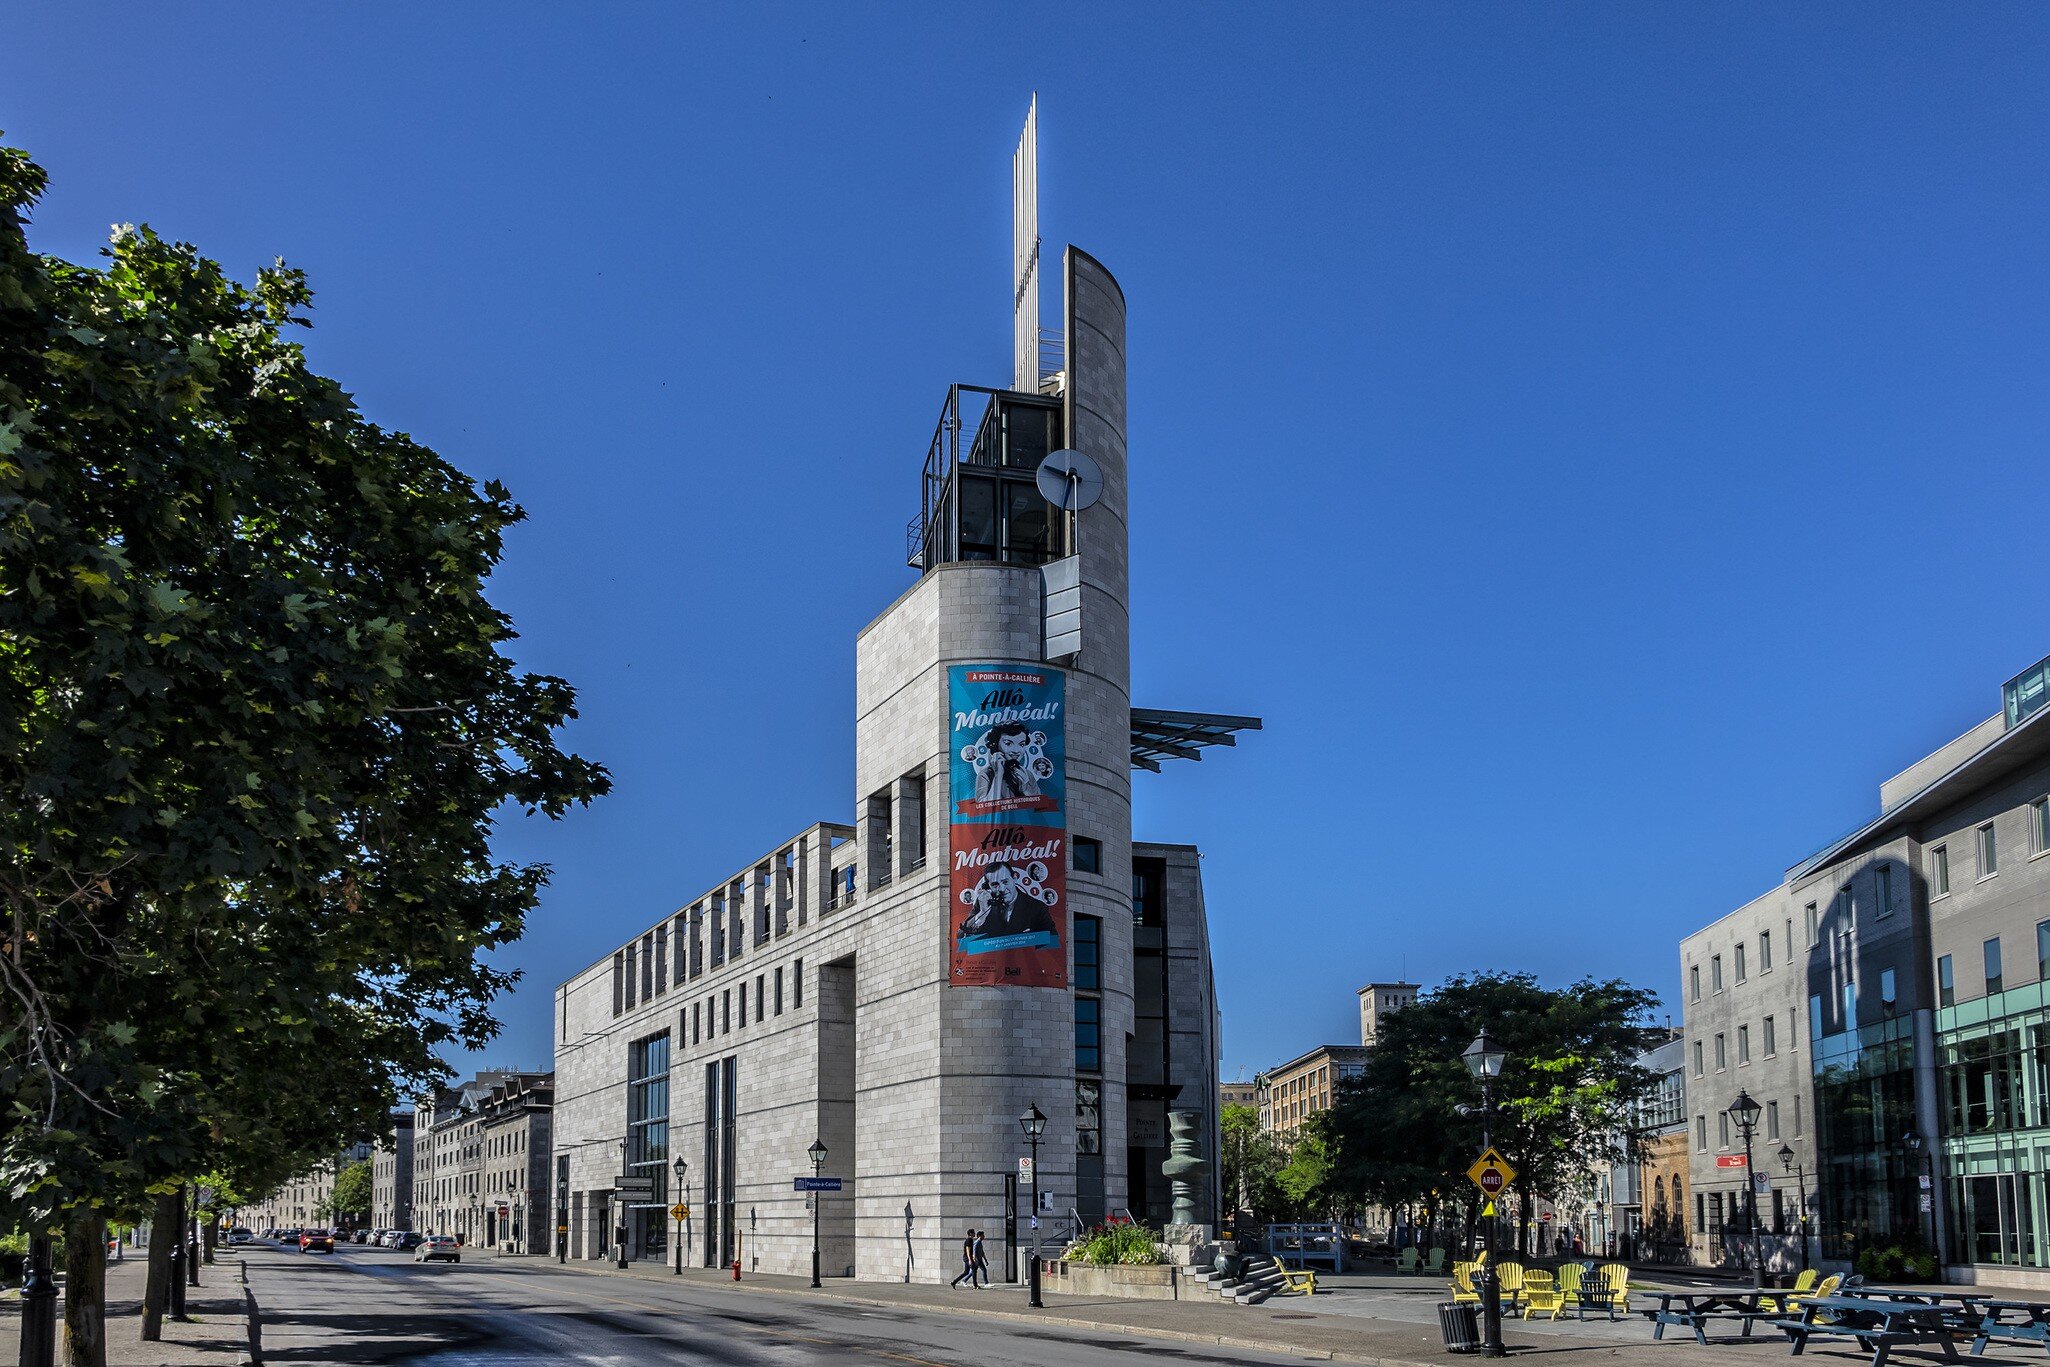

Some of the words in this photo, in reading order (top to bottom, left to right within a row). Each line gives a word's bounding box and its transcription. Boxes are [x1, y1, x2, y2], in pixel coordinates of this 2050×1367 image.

[978, 673, 1041, 684] POINTE-À-CALLIÈRE
[980, 687, 1027, 711] Allô
[954, 702, 1059, 732] Montréal!
[980, 826, 1027, 850] Allô
[954, 839, 1061, 871] Montréal!
[1004, 966, 1021, 976] Bell
